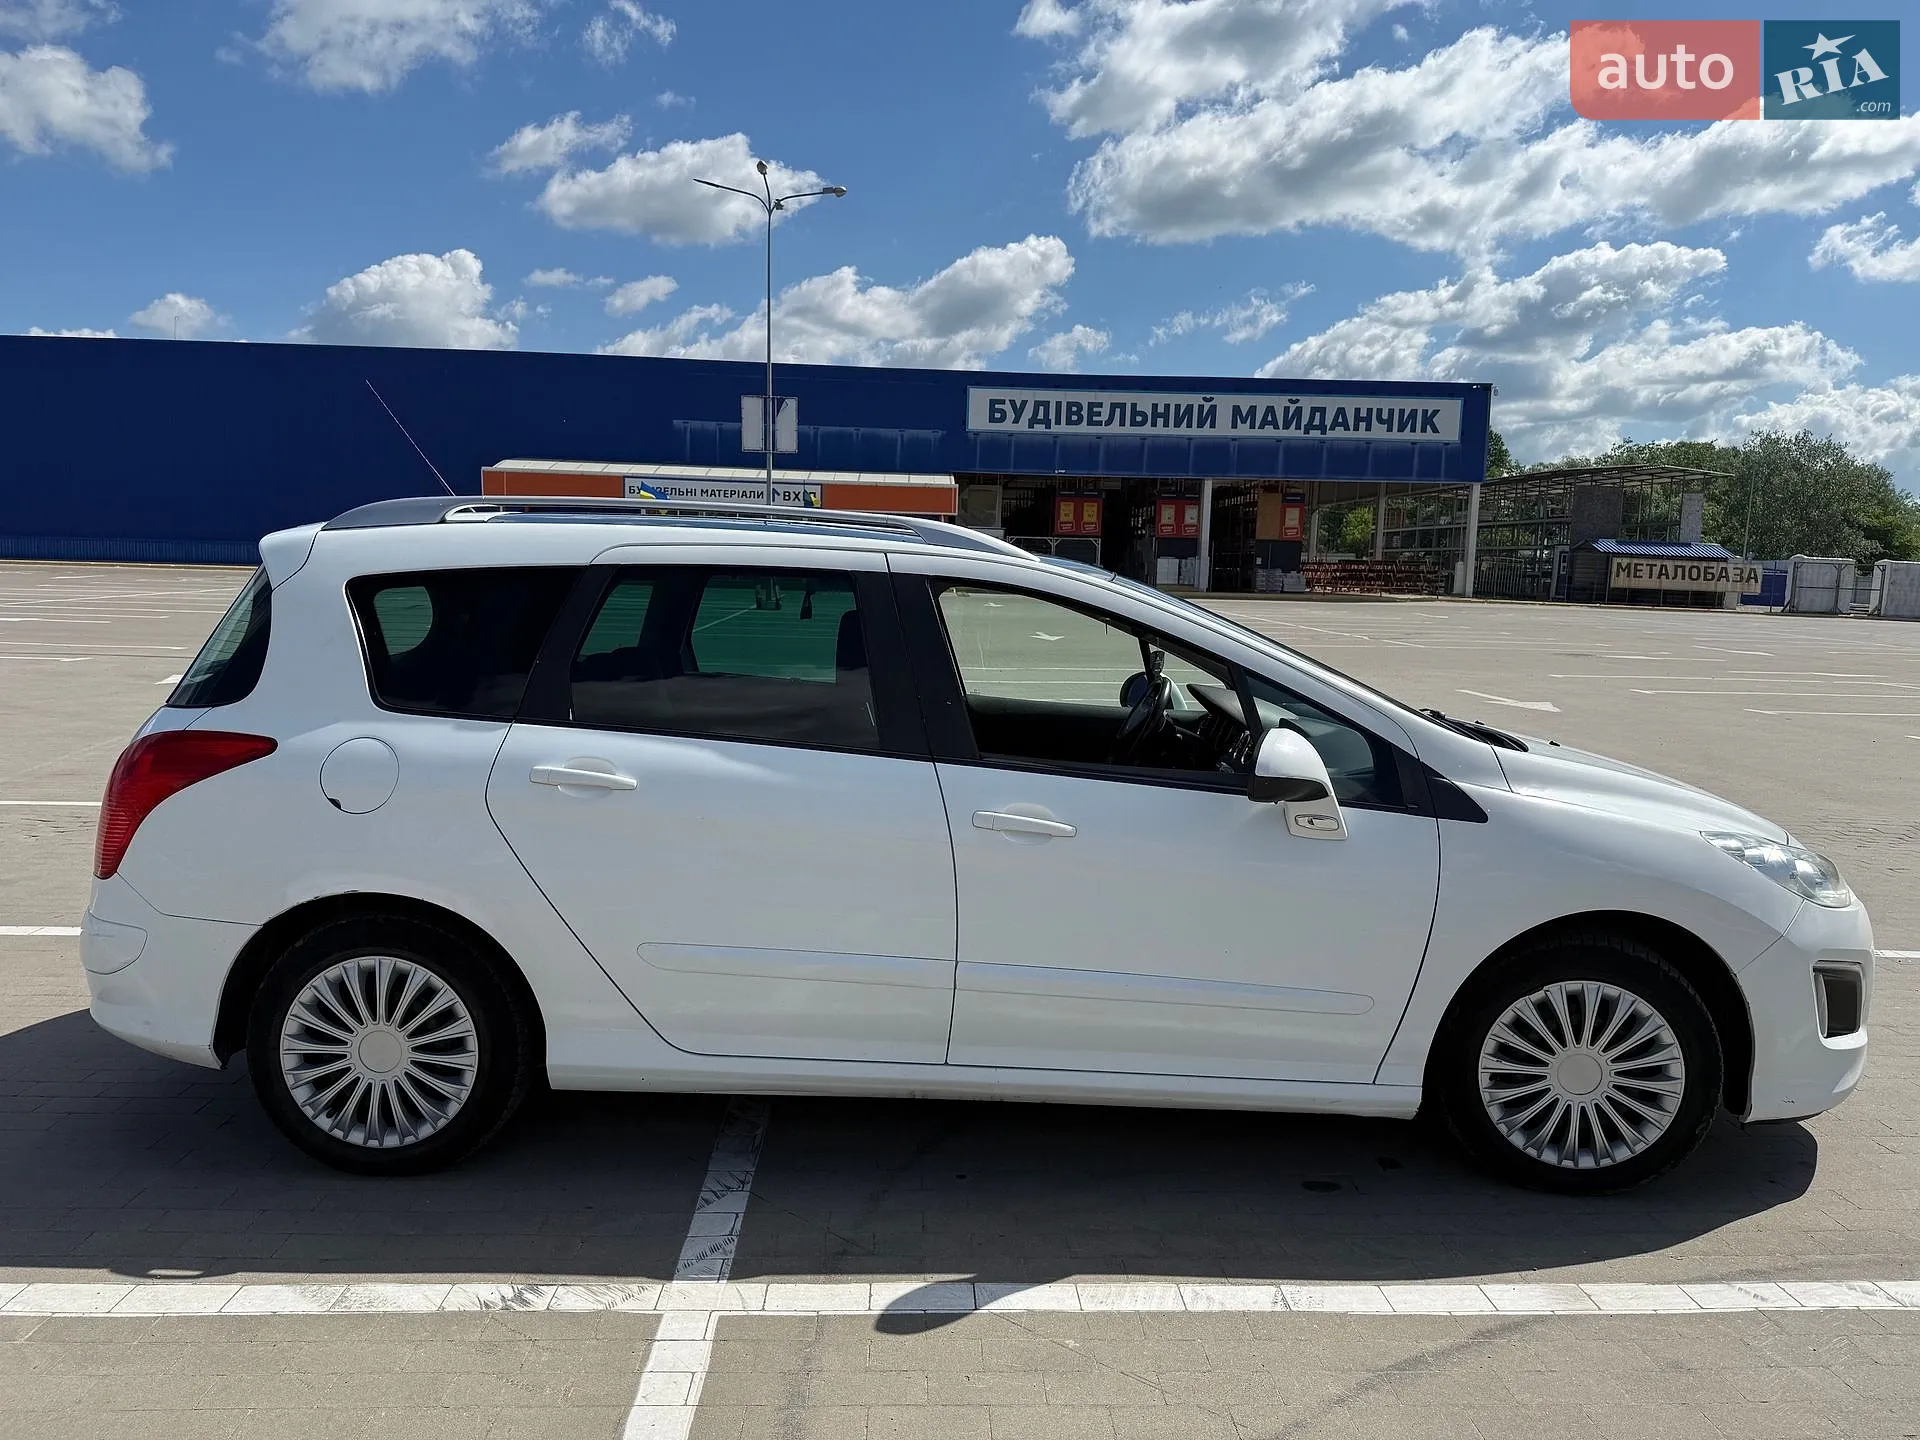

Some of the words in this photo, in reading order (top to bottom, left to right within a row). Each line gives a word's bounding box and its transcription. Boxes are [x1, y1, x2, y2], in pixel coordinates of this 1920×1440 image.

[988, 396, 1218, 429] БУДІВЕЛЬНИЙ
[1231, 398, 1441, 435] МАЙДАНЧИК
[628, 485, 697, 497] БУЕЛЬНІ
[700, 488, 764, 500] МАТЕРІАЛИ
[1615, 562, 1760, 584] МЕТАЛОБАЗА
